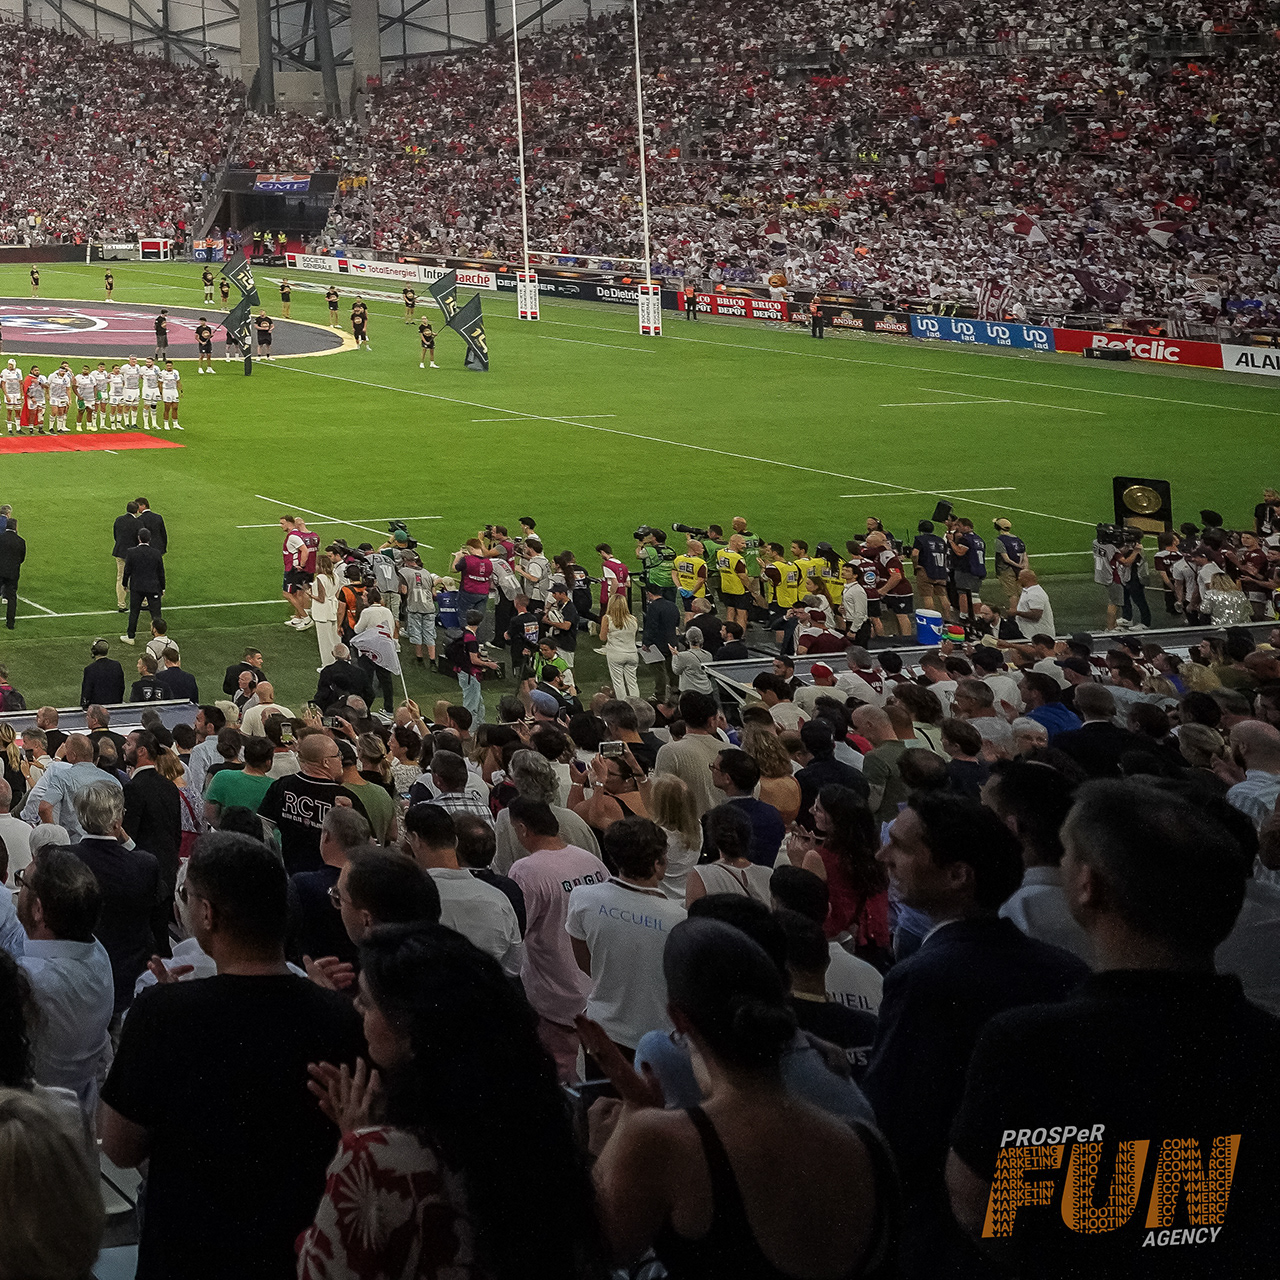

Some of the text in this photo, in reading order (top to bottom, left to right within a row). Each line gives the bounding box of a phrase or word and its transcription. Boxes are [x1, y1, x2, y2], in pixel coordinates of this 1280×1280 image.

[259, 182, 306, 191] GMF
[367, 265, 416, 278] TotalEnergies
[423, 268, 490, 286] Interarché
[497, 279, 555, 292] DEFER
[610, 288, 639, 300] Dietric
[717, 297, 745, 307] BRICO
[752, 300, 781, 310] BRICO
[833, 317, 863, 327] ANDROS
[876, 322, 907, 332] ANDROS
[1092, 335, 1180, 362] Betclic
[1235, 352, 1280, 370] ALAI
[282, 791, 331, 823] RCT
[599, 904, 668, 933] ACCUEIL
